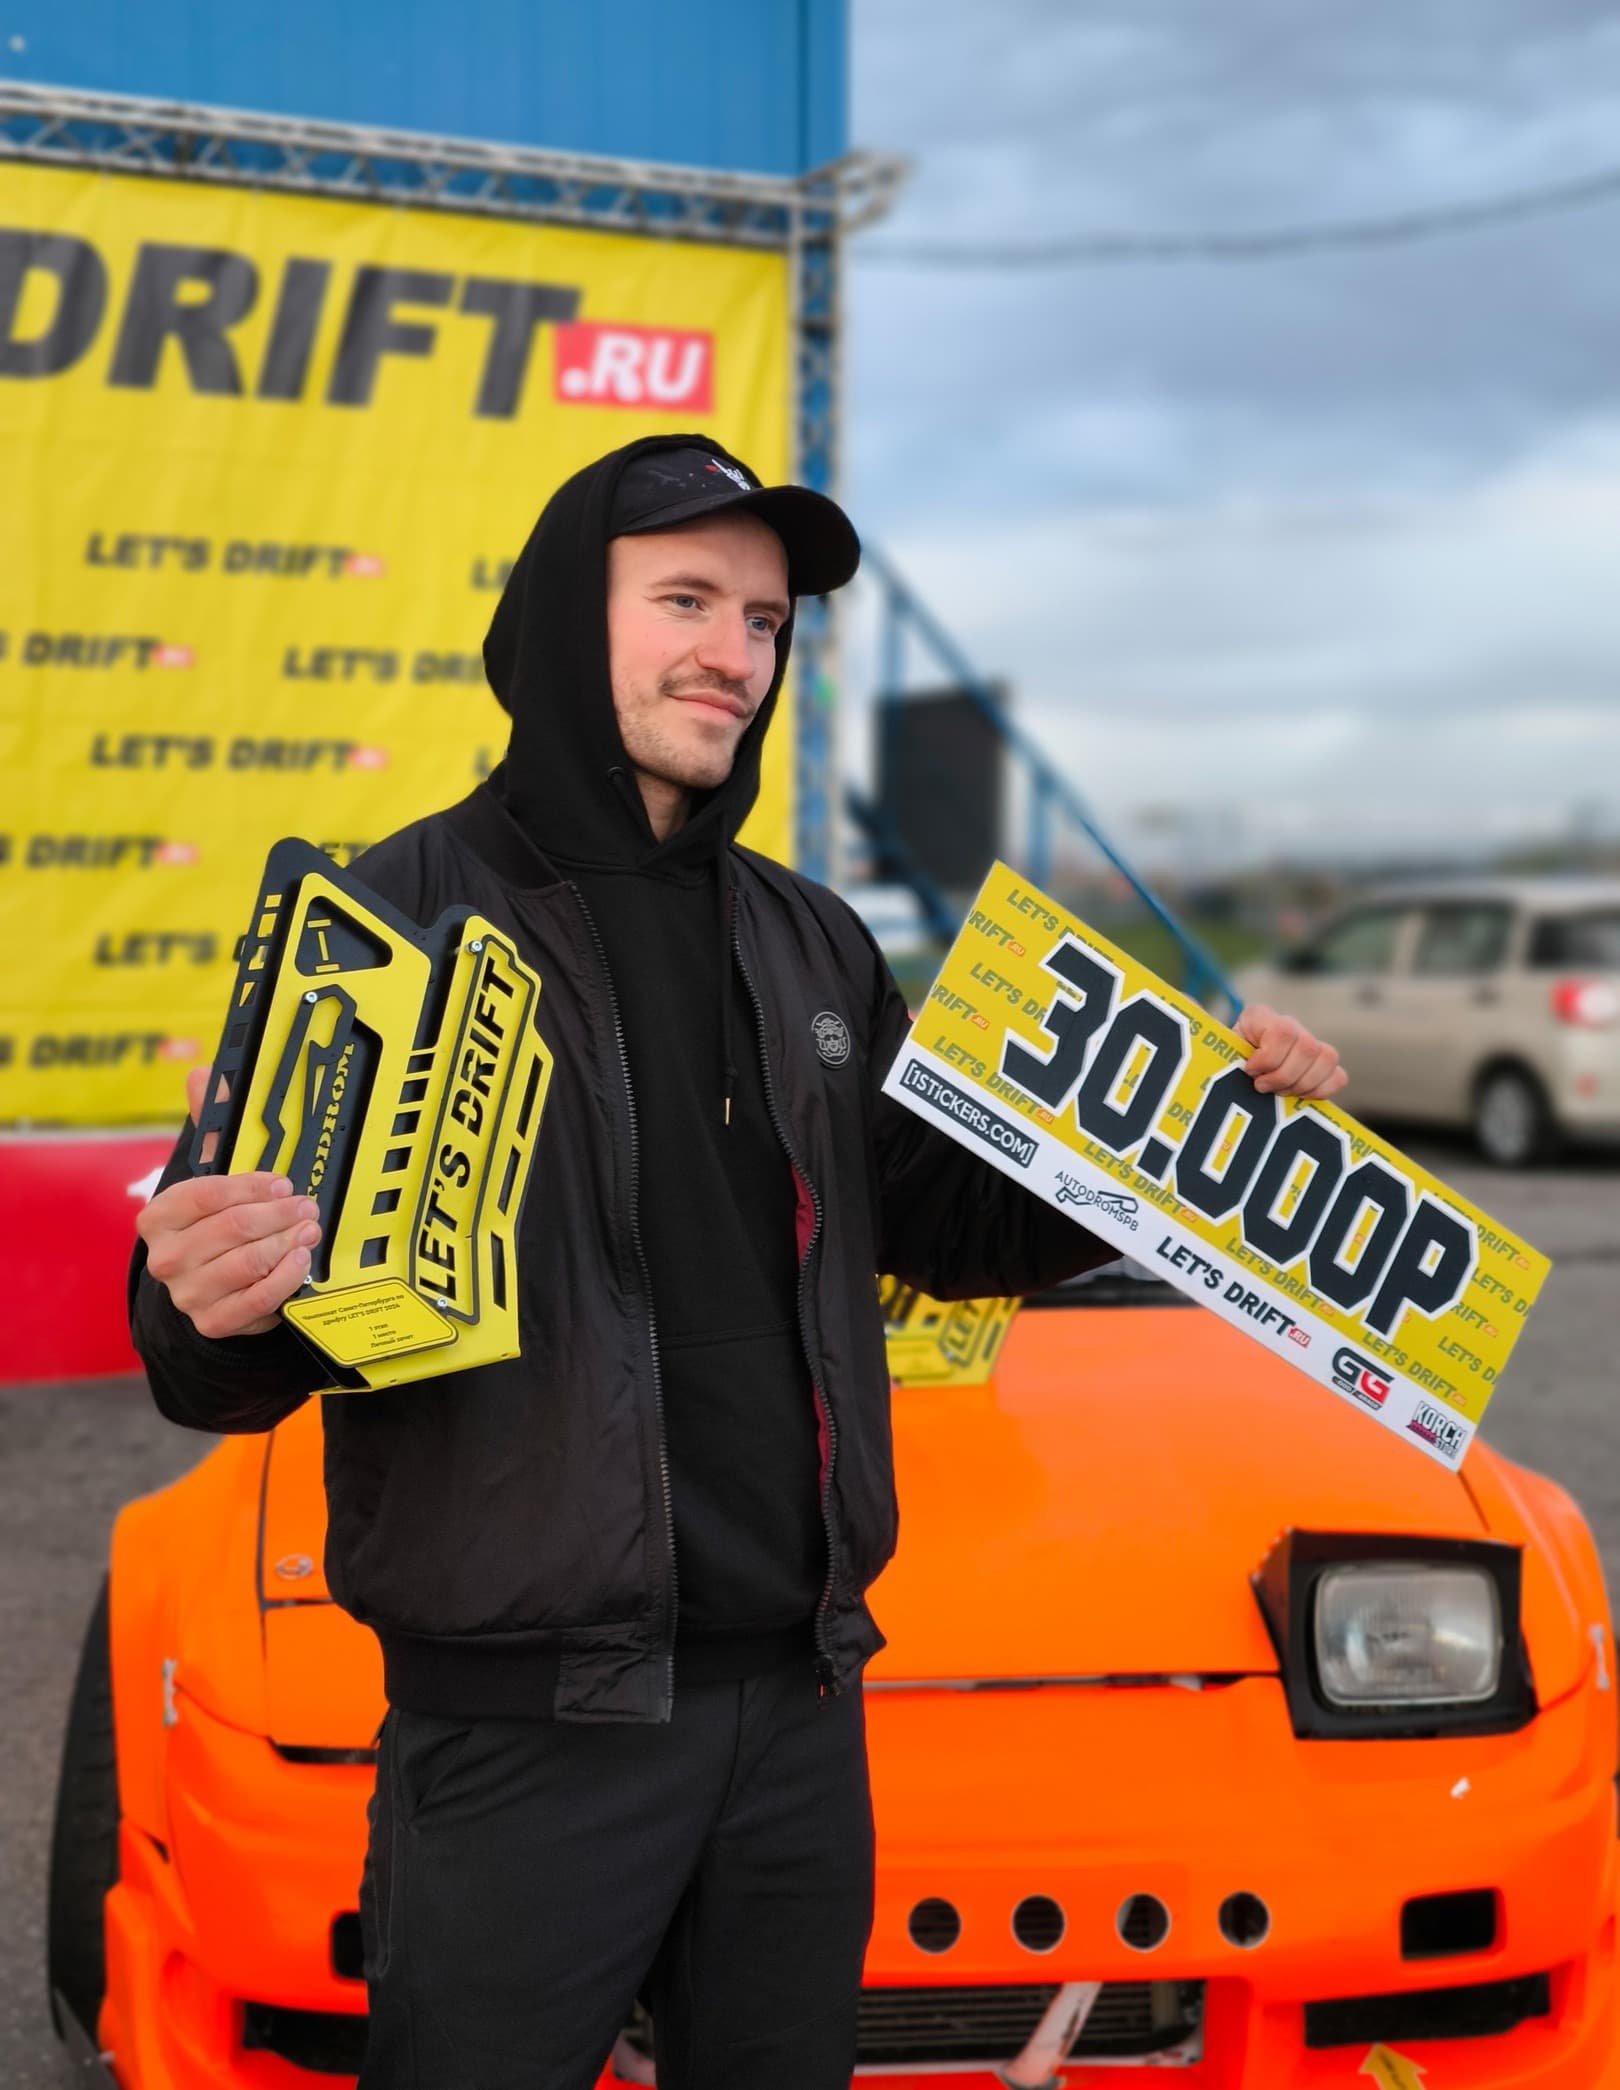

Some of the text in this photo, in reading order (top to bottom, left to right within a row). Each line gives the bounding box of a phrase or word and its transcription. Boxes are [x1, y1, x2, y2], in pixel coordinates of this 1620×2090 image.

[1006, 889, 1059, 932] LET'S
[970, 962, 1022, 1005] LET'S
[933, 1036, 986, 1079] LET'S
[418, 957, 514, 1302] LET'S DRIFT
[1084, 1141, 1135, 1180] LET'S
[1054, 1170, 1140, 1232] AUTODROMSPB
[1156, 1235, 1224, 1291] LET'S
[1437, 1335, 1482, 1373] LET'S
